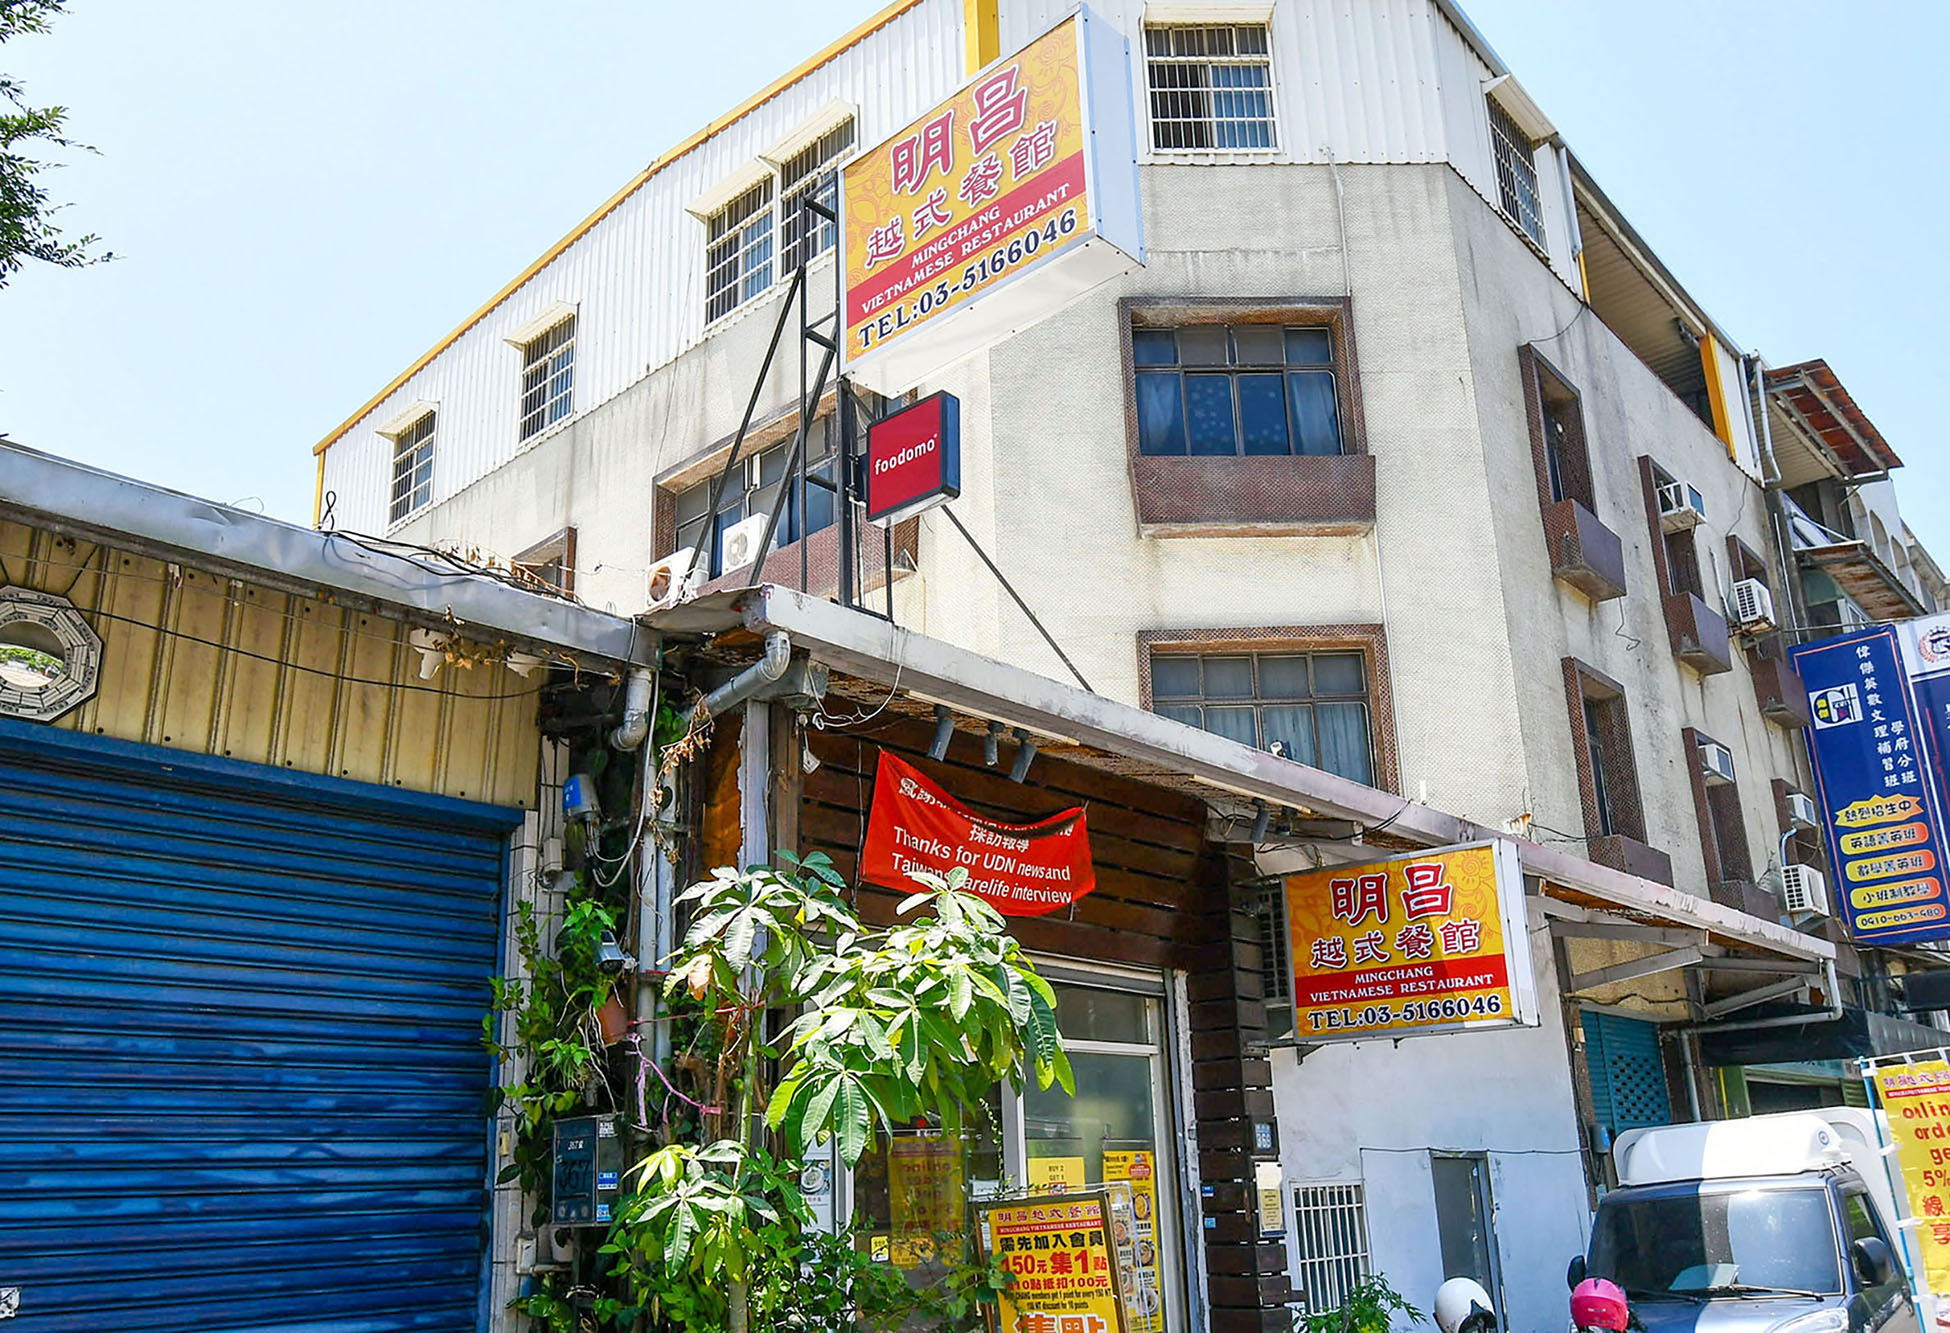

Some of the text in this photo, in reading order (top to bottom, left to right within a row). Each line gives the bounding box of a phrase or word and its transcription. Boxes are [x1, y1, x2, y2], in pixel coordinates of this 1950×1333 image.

[890, 64, 1028, 195] 明昌
[865, 120, 1057, 269] 越式餐館
[861, 183, 1071, 314] VIETNAMESE RESTAURANT
[911, 206, 1000, 268] MINGCHANG
[857, 209, 1077, 350] TEL:03-5166046
[875, 438, 935, 475] foodomo
[894, 826, 952, 860] Thanks
[955, 846, 981, 866] for
[983, 853, 1018, 874] UDN
[1011, 882, 1072, 904] interview
[1329, 862, 1453, 927] 明昌
[1310, 919, 1480, 969] 越式餐館
[1310, 973, 1494, 1003] VIETNAMESE RESTAURANT
[1354, 966, 1434, 985] MINGCHANG
[1307, 993, 1502, 1030] TEL:03-5166046
[1000, 1230, 1104, 1252] 需先加入會員
